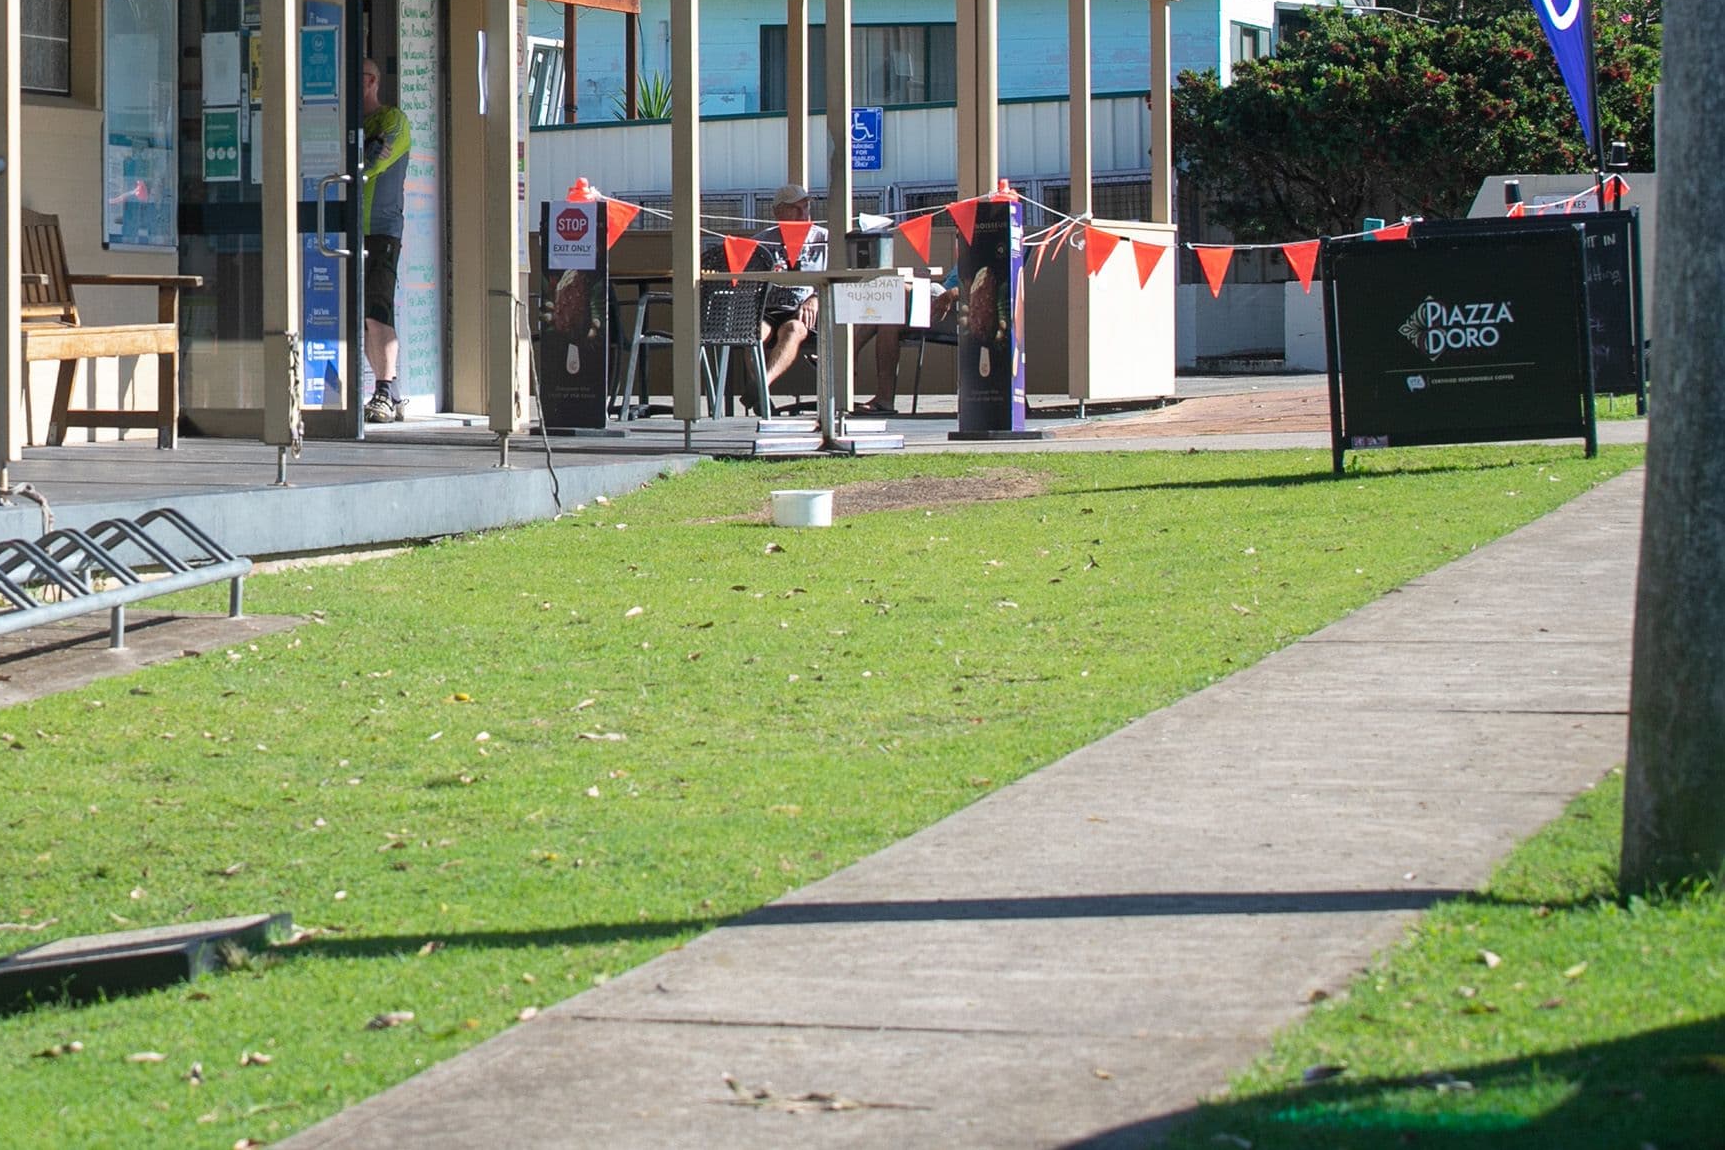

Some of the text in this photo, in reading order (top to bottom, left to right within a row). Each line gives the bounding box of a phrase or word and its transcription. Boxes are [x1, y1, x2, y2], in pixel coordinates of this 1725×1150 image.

[558, 218, 587, 231] STOP
[570, 244, 592, 252] ONLY
[1426, 301, 1514, 328] PIAZZA
